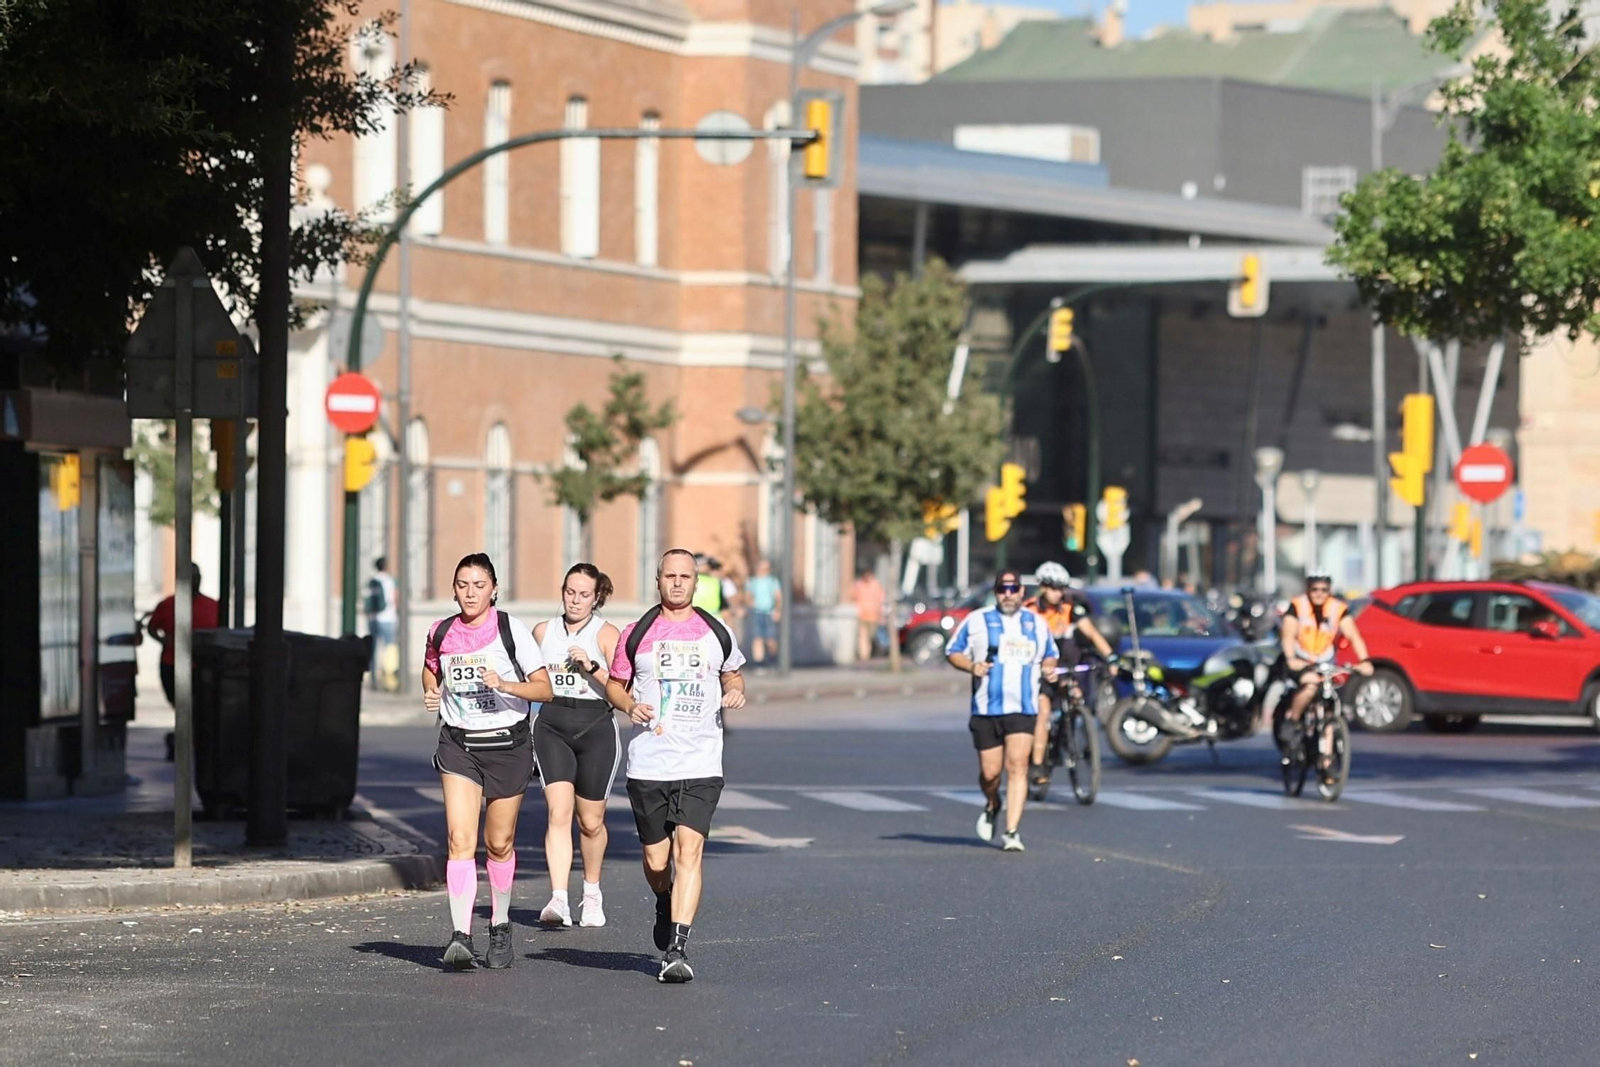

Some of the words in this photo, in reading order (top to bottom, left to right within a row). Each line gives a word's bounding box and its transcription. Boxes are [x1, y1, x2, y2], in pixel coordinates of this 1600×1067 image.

[660, 653, 701, 667] 216
[554, 674, 576, 686] 80
[467, 699, 496, 711] 2025
[673, 703, 702, 714] 2025
